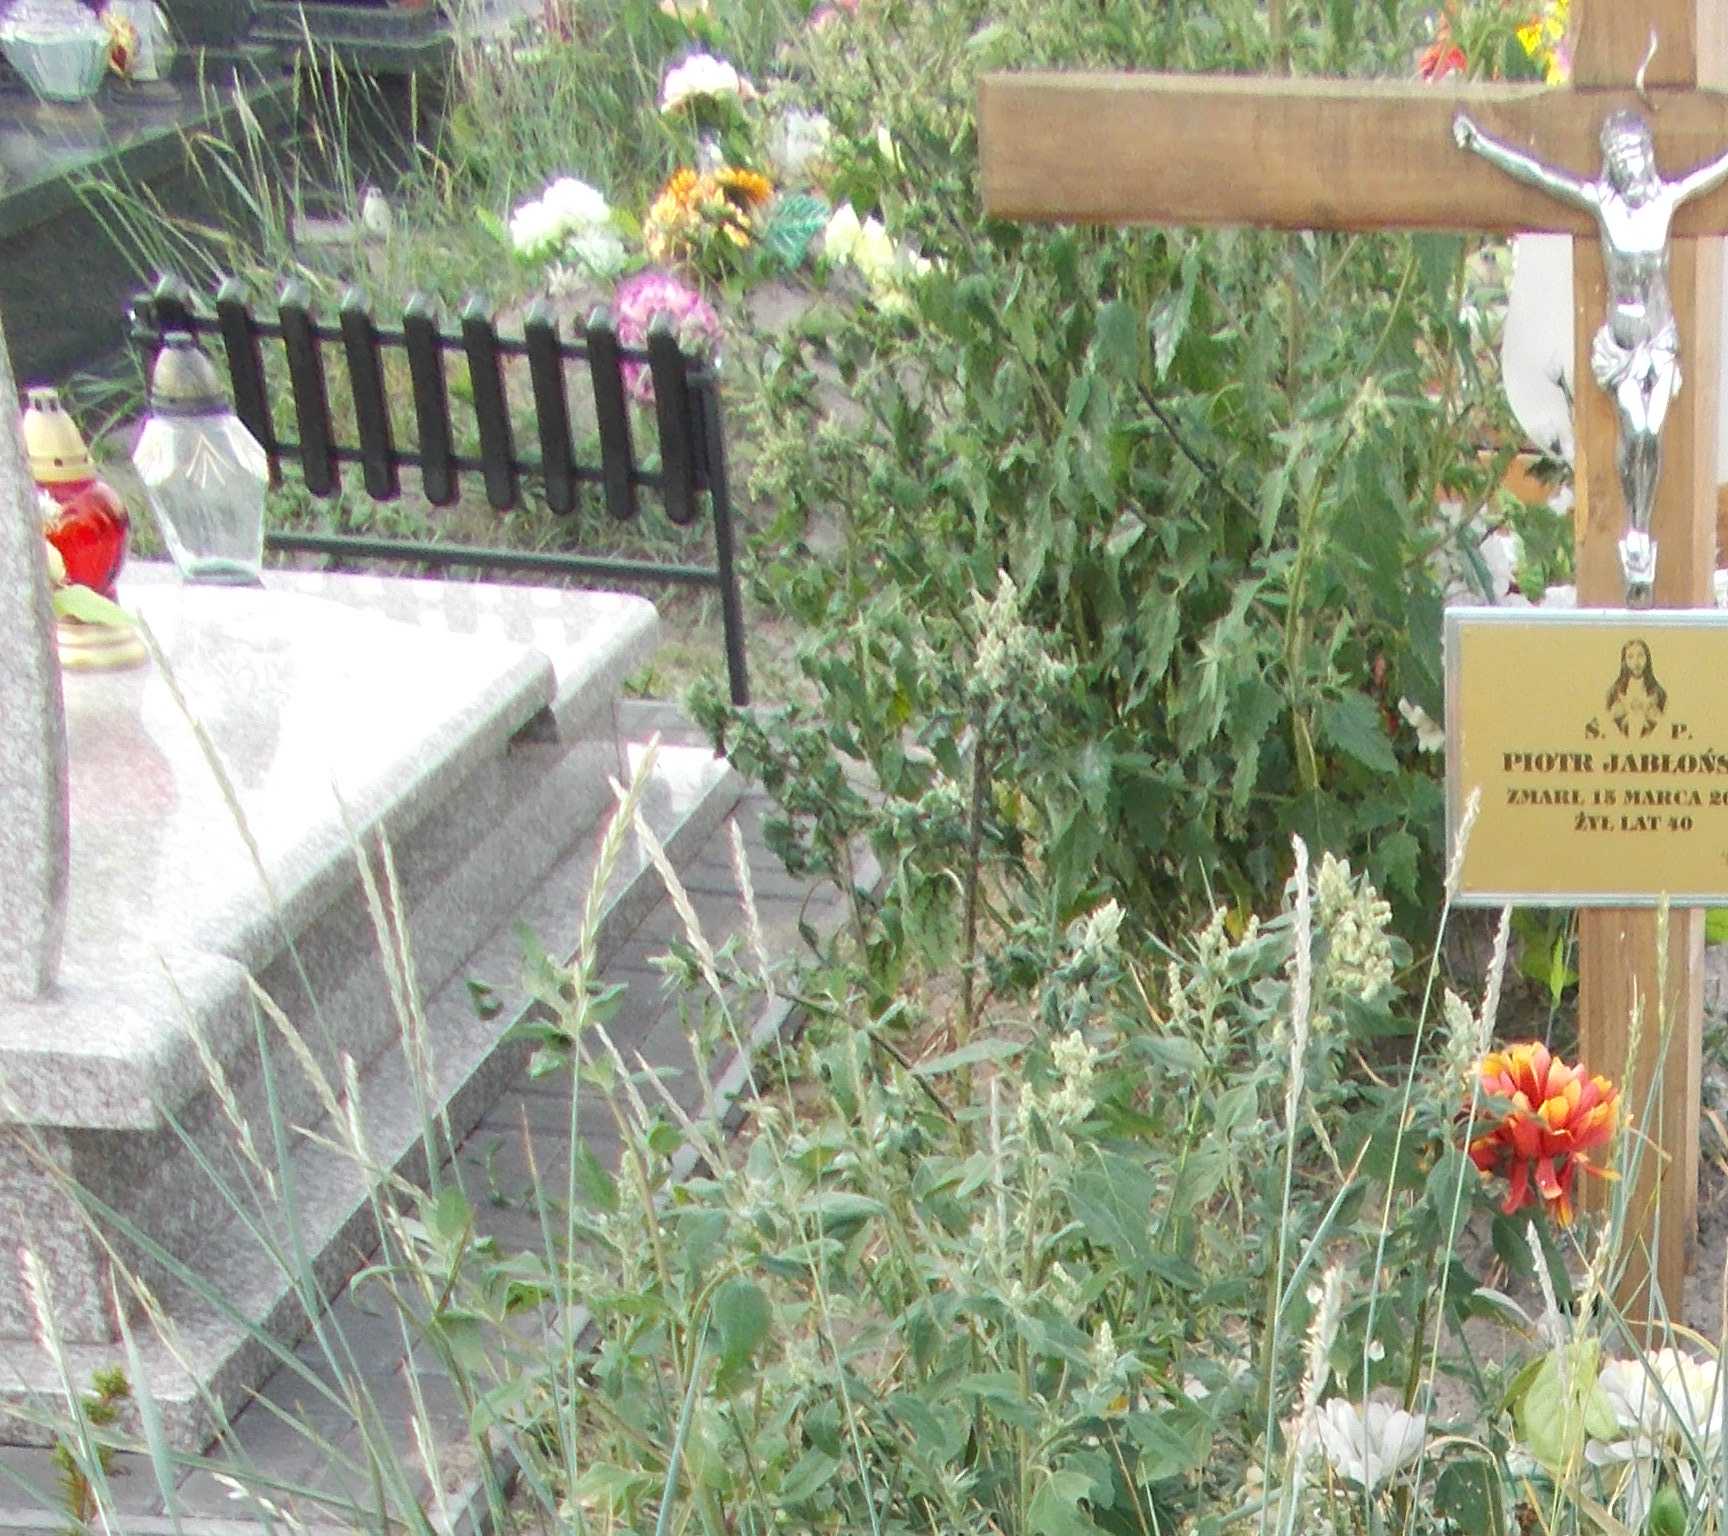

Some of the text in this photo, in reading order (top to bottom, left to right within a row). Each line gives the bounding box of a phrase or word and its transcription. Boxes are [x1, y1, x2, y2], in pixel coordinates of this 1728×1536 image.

[1671, 722, 1693, 740] P.
[1502, 752, 1594, 773] PIOTR
[1506, 788, 1585, 806] ZMARŁ
[1592, 789, 1617, 806] 15
[1623, 789, 1703, 806] MARCA
[1574, 811, 1693, 832] ŻYŁ LAT 40
